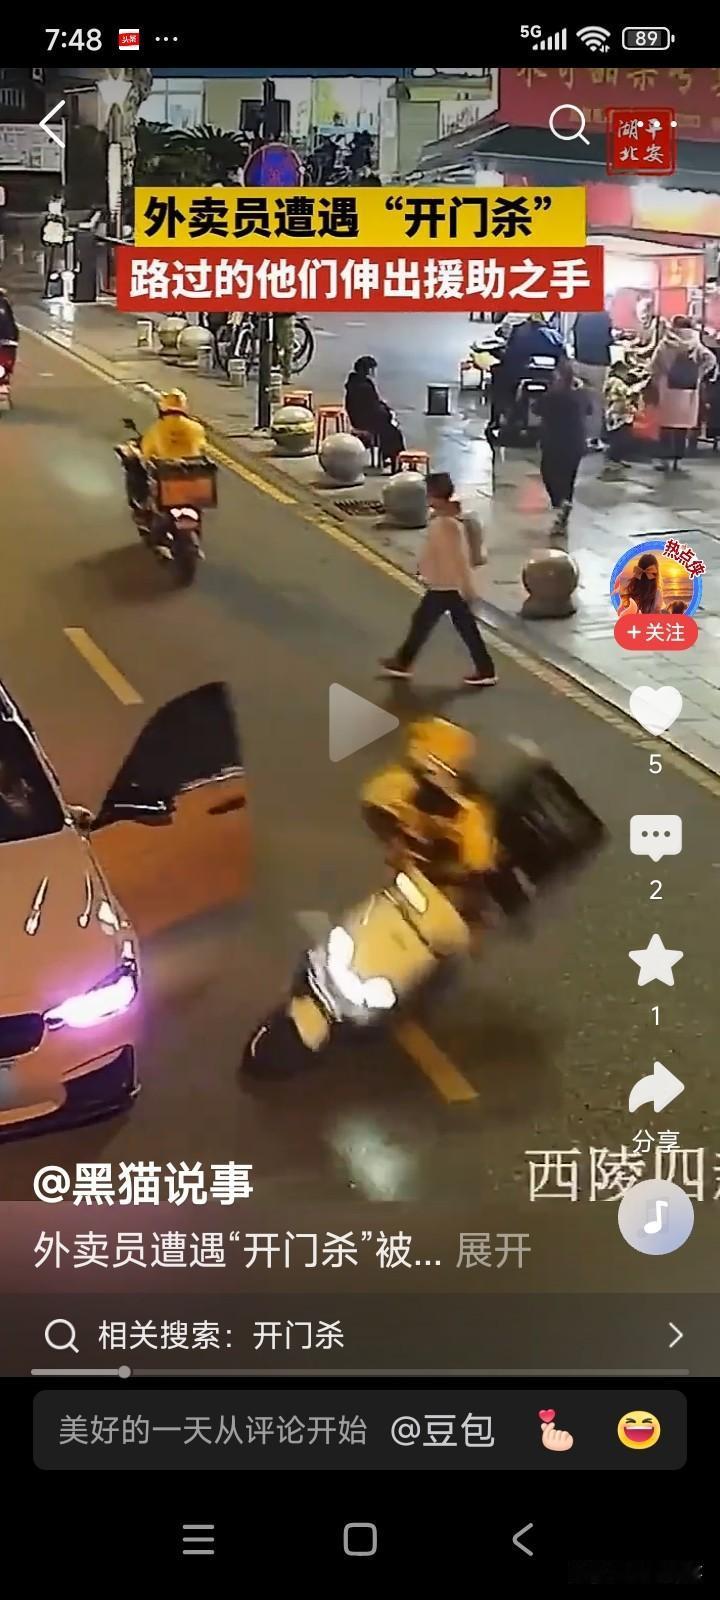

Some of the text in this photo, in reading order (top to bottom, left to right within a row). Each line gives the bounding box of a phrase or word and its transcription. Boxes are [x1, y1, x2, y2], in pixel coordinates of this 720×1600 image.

[45, 28, 103, 51] 7:48
[520, 25, 542, 38] 5G
[635, 30, 658, 46] 89
[649, 753, 663, 774] 5
[649, 879, 663, 900] 2
[650, 1006, 660, 1026] 1
[632, 1129, 681, 1153] 分享
[33, 1160, 254, 1206] @黑猫说事
[456, 1232, 532, 1269] 展开
[59, 1412, 495, 1448] 美好的一天从评论开始 @豆包
